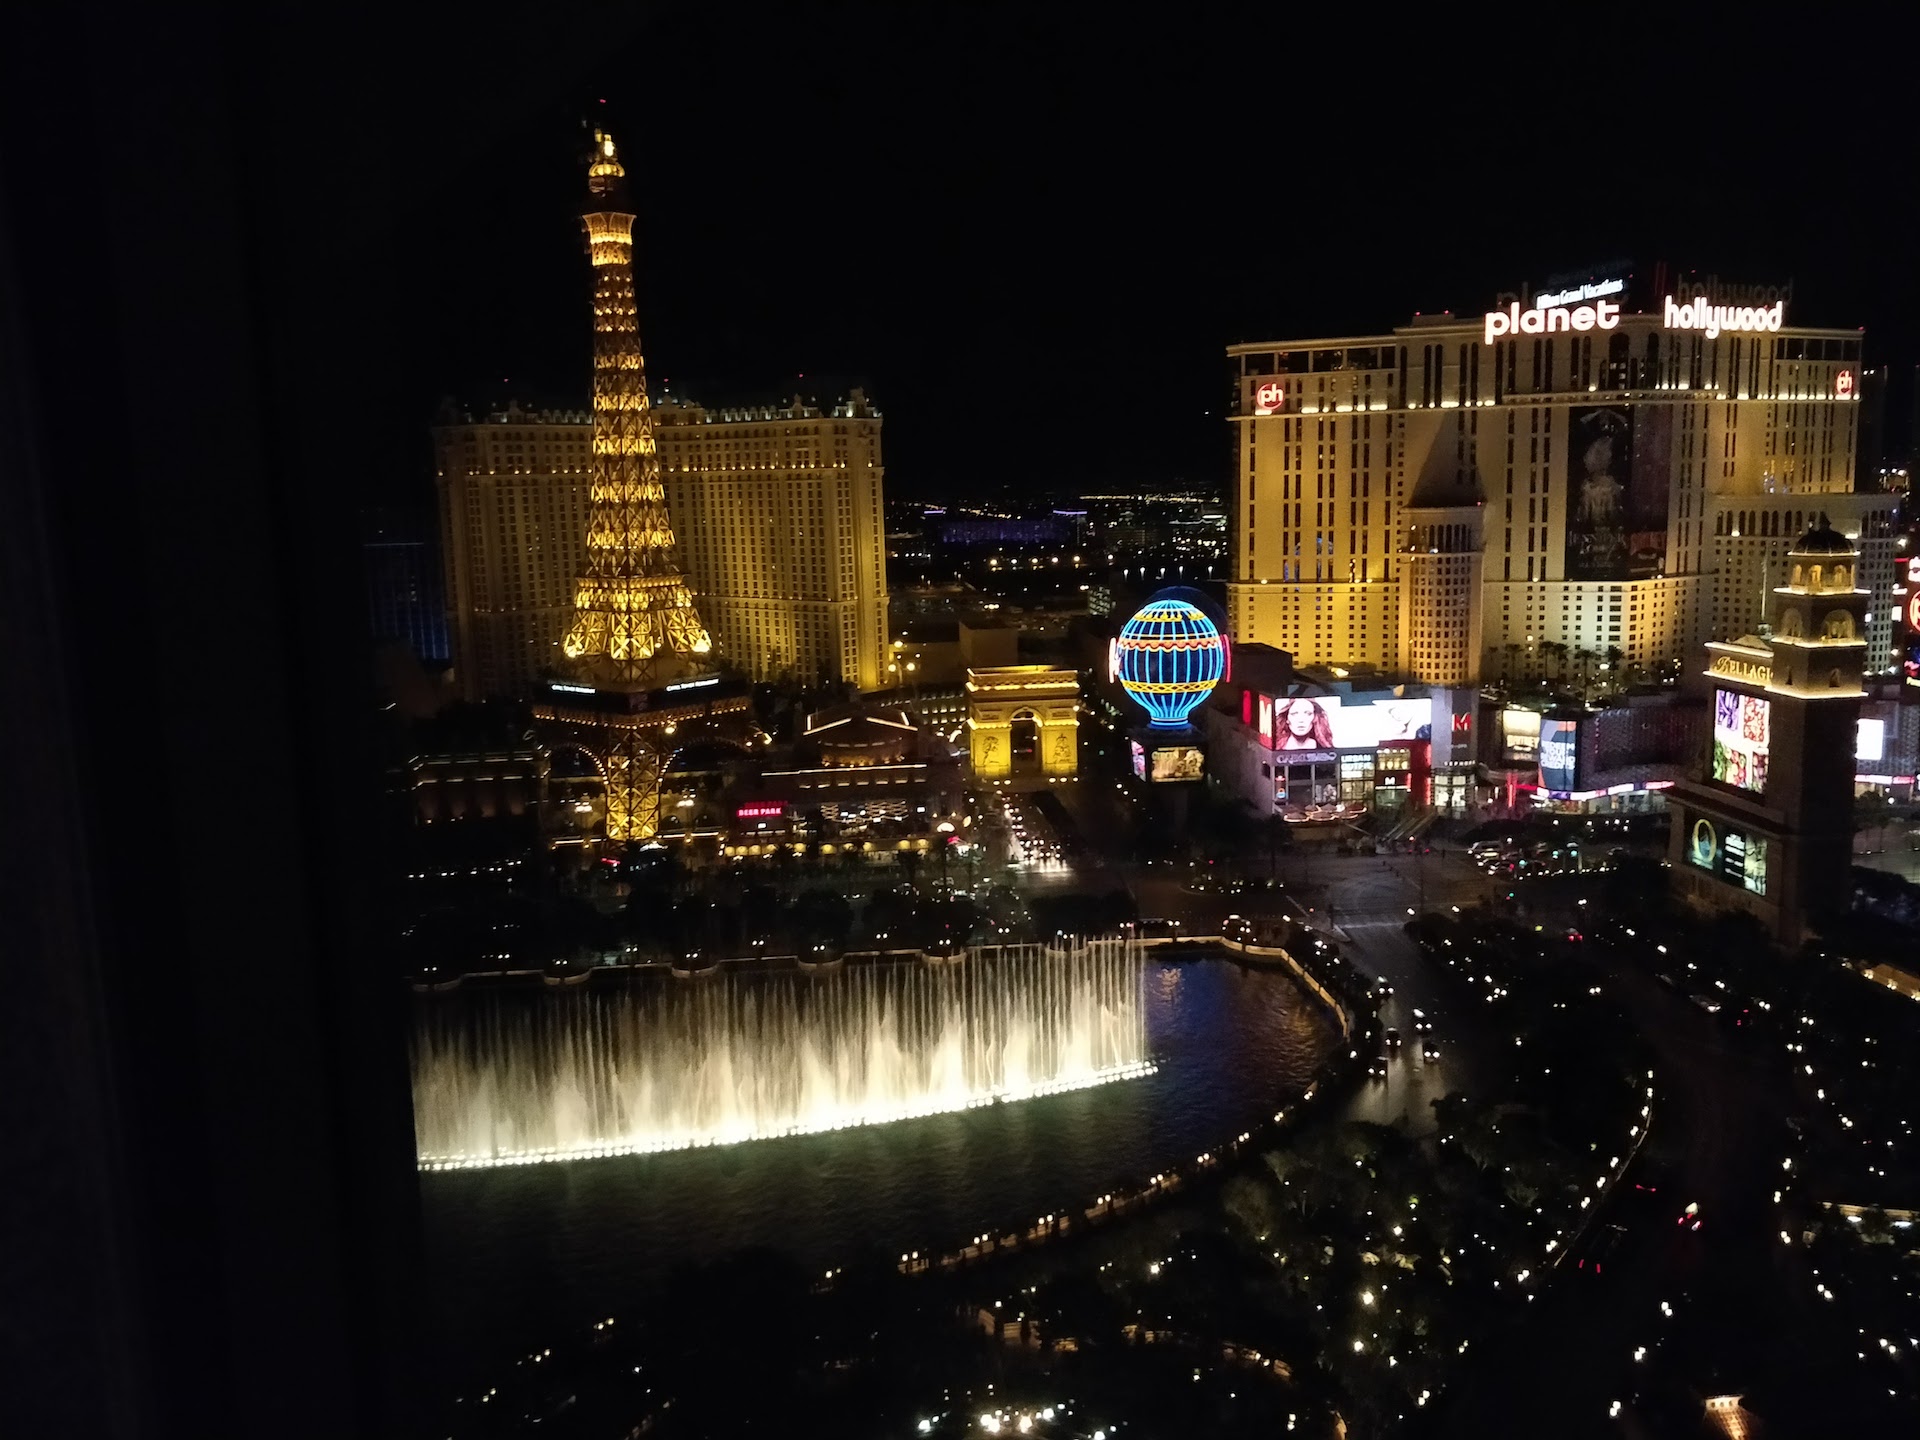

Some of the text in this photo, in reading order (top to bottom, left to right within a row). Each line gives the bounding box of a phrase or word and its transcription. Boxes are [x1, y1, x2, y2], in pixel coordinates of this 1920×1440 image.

[1485, 295, 1783, 345] planet hollywood
[1260, 383, 1284, 406] ph
[738, 807, 782, 817] BEER PARK
